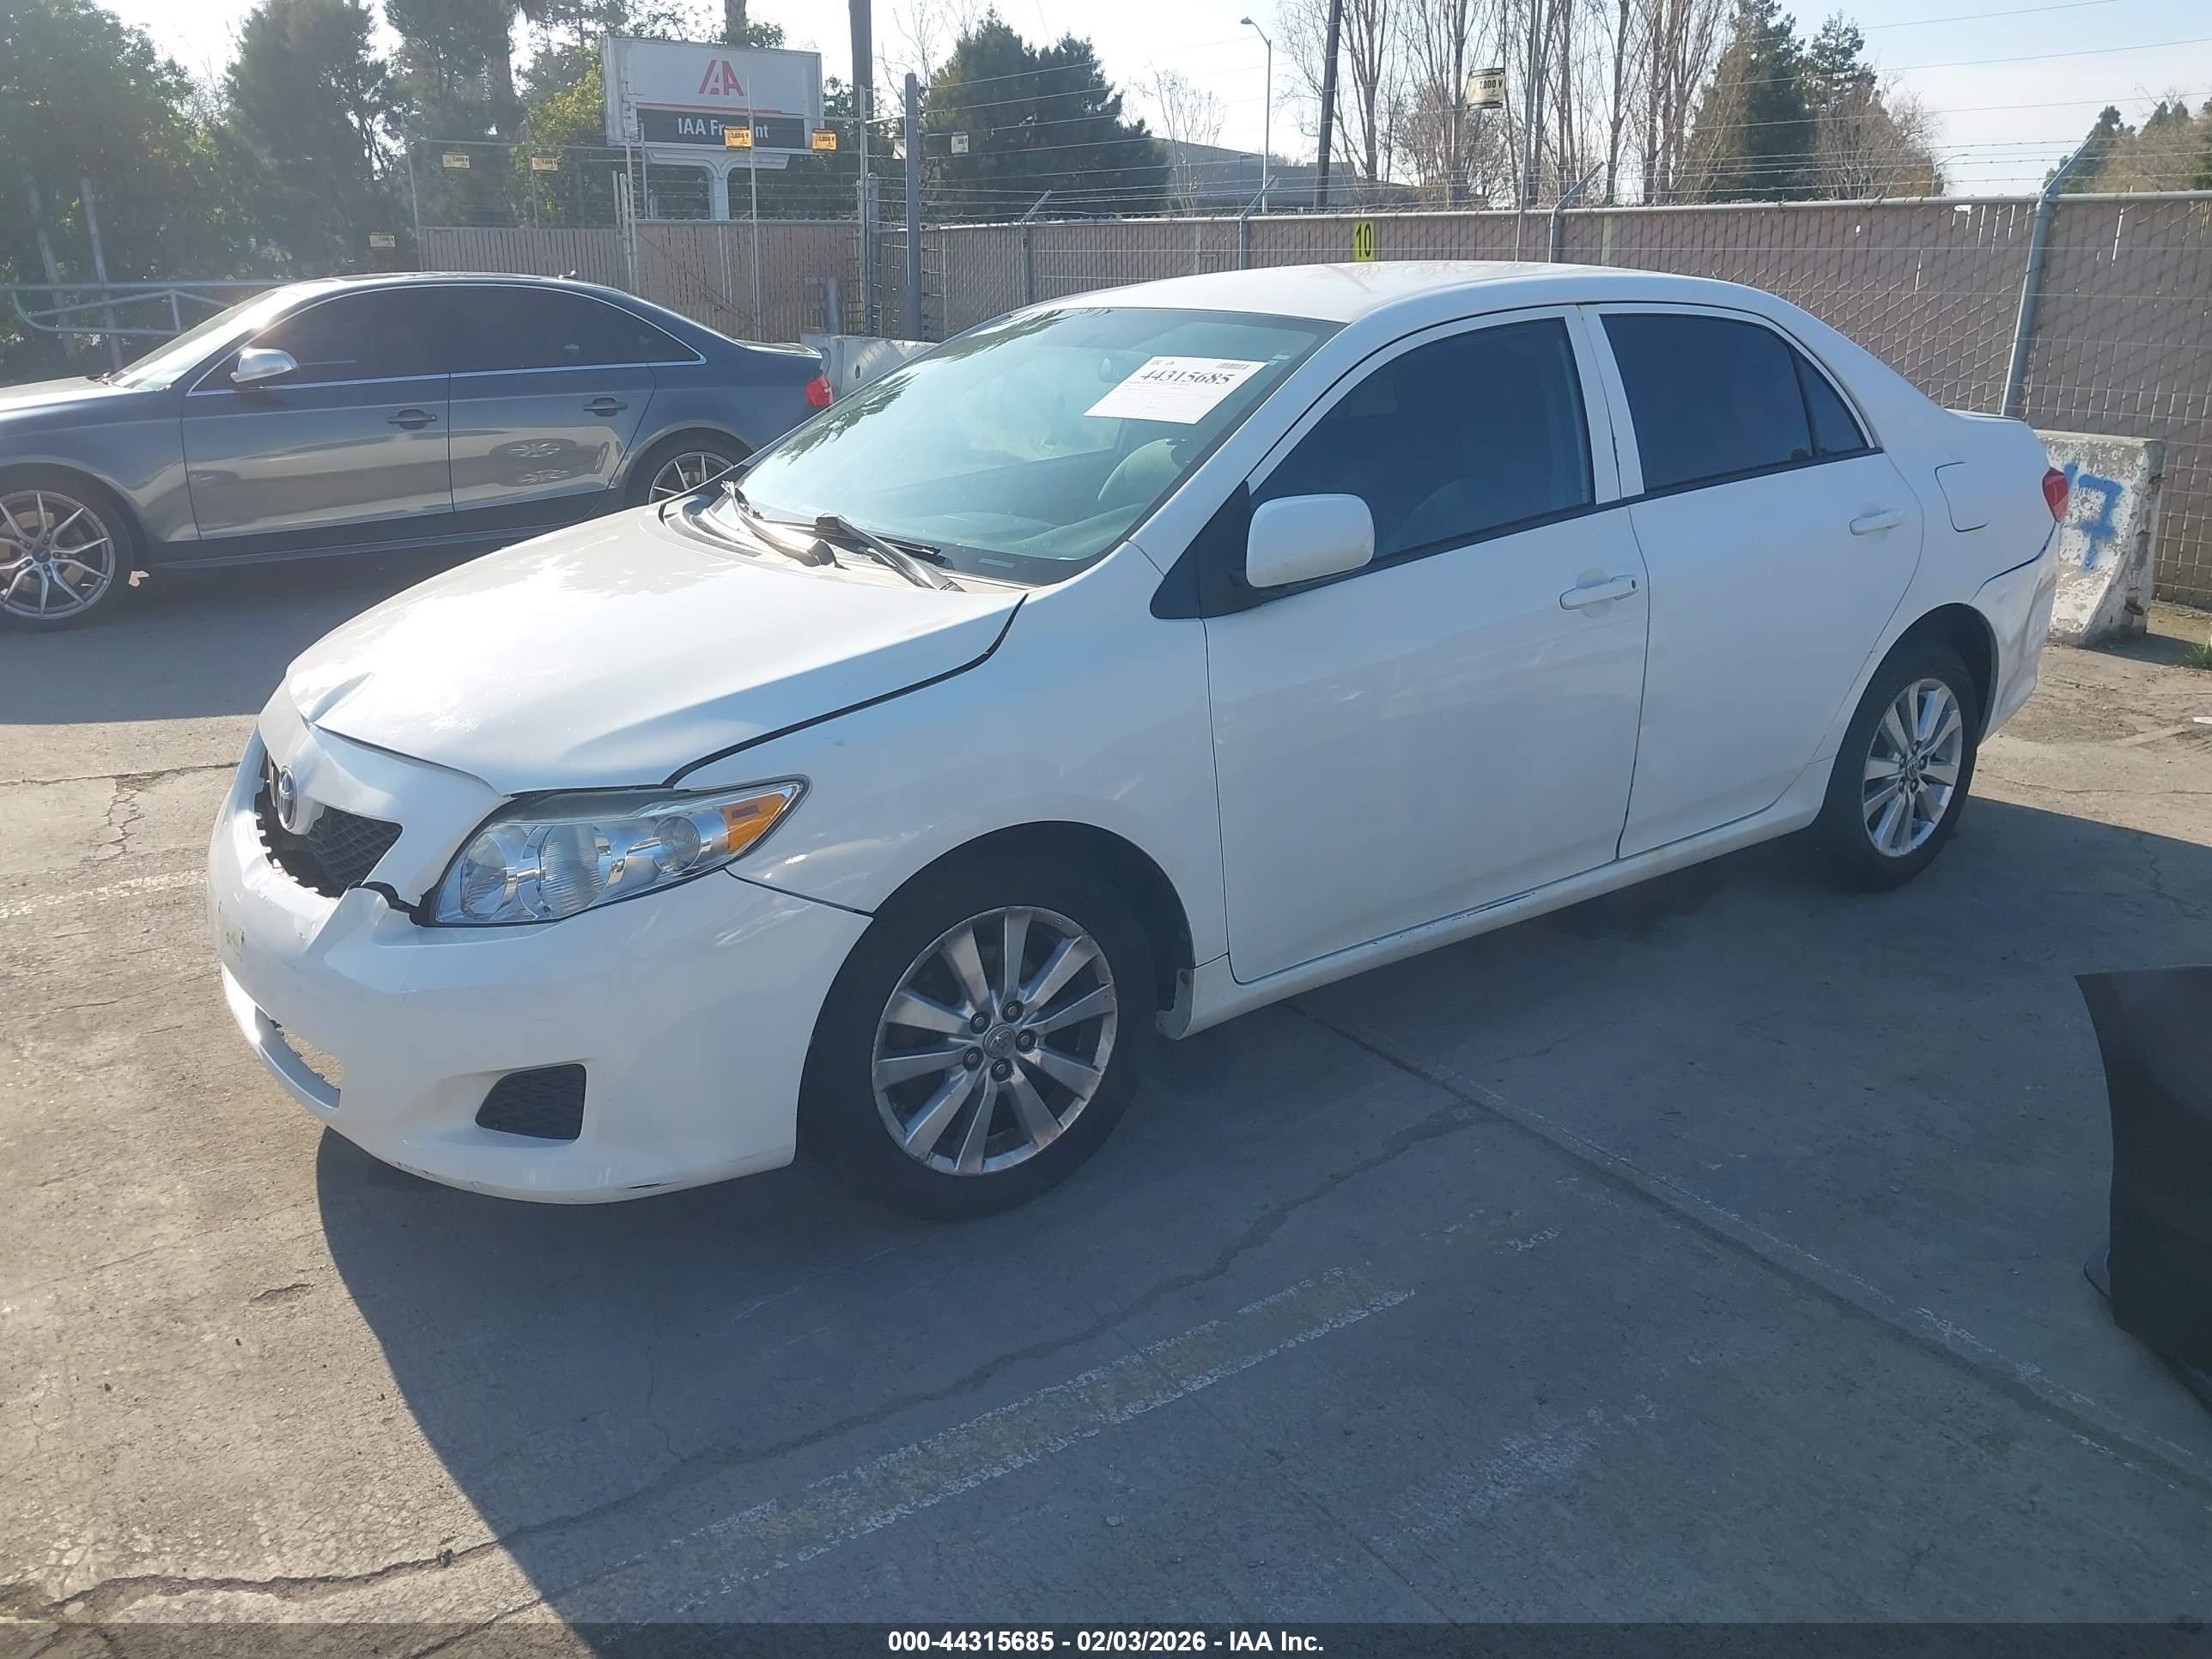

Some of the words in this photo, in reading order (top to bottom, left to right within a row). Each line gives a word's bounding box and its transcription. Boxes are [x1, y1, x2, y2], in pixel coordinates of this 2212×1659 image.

[1498, 78, 1504, 88] V
[678, 118, 707, 136] IAA
[709, 120, 769, 138] Frnt
[1356, 222, 1372, 258] 10
[1139, 369, 1237, 386] 44315685
